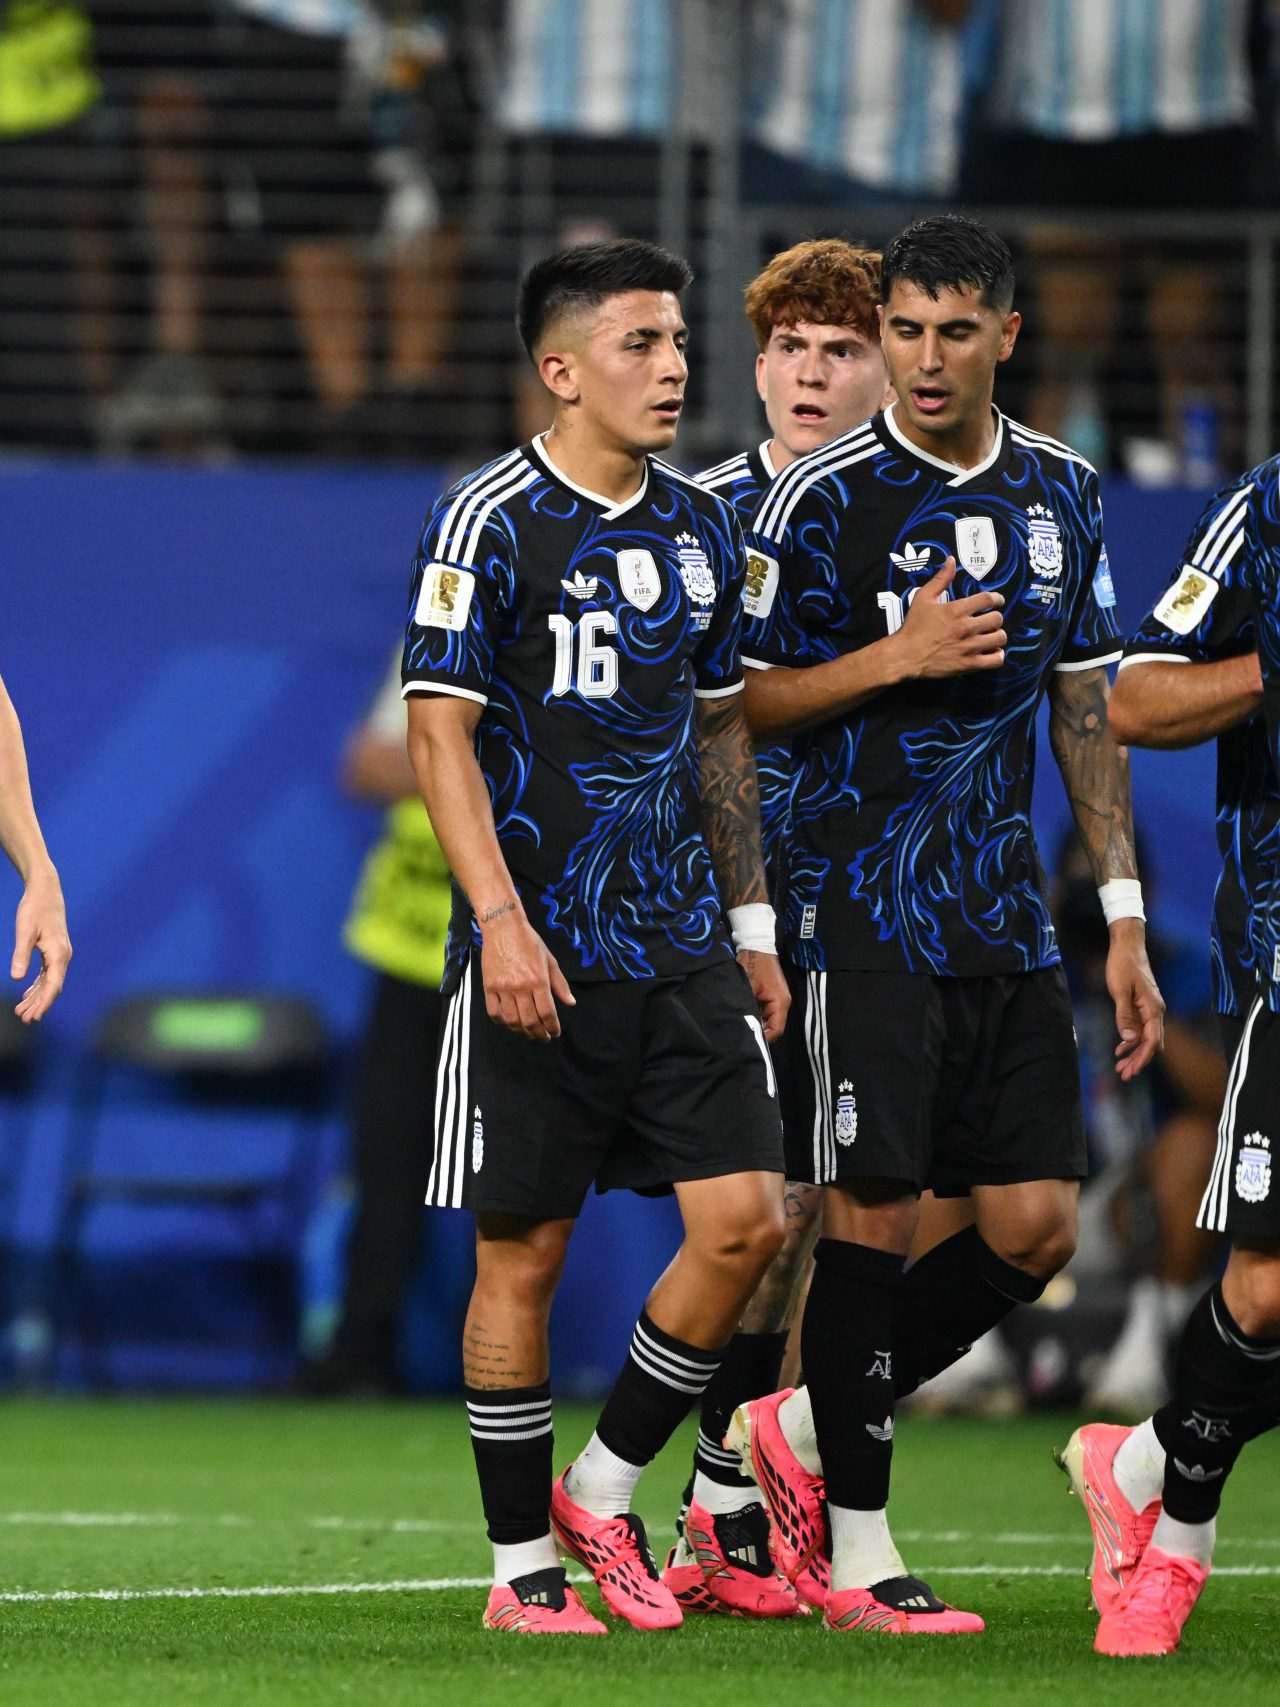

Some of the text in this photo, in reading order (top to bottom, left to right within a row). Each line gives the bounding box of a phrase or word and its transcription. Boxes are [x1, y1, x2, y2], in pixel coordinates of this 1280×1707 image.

[970, 556, 986, 564] FIFA
[634, 587, 652, 596] FIFA
[548, 611, 619, 698] 16
[744, 1014, 778, 1098] 1
